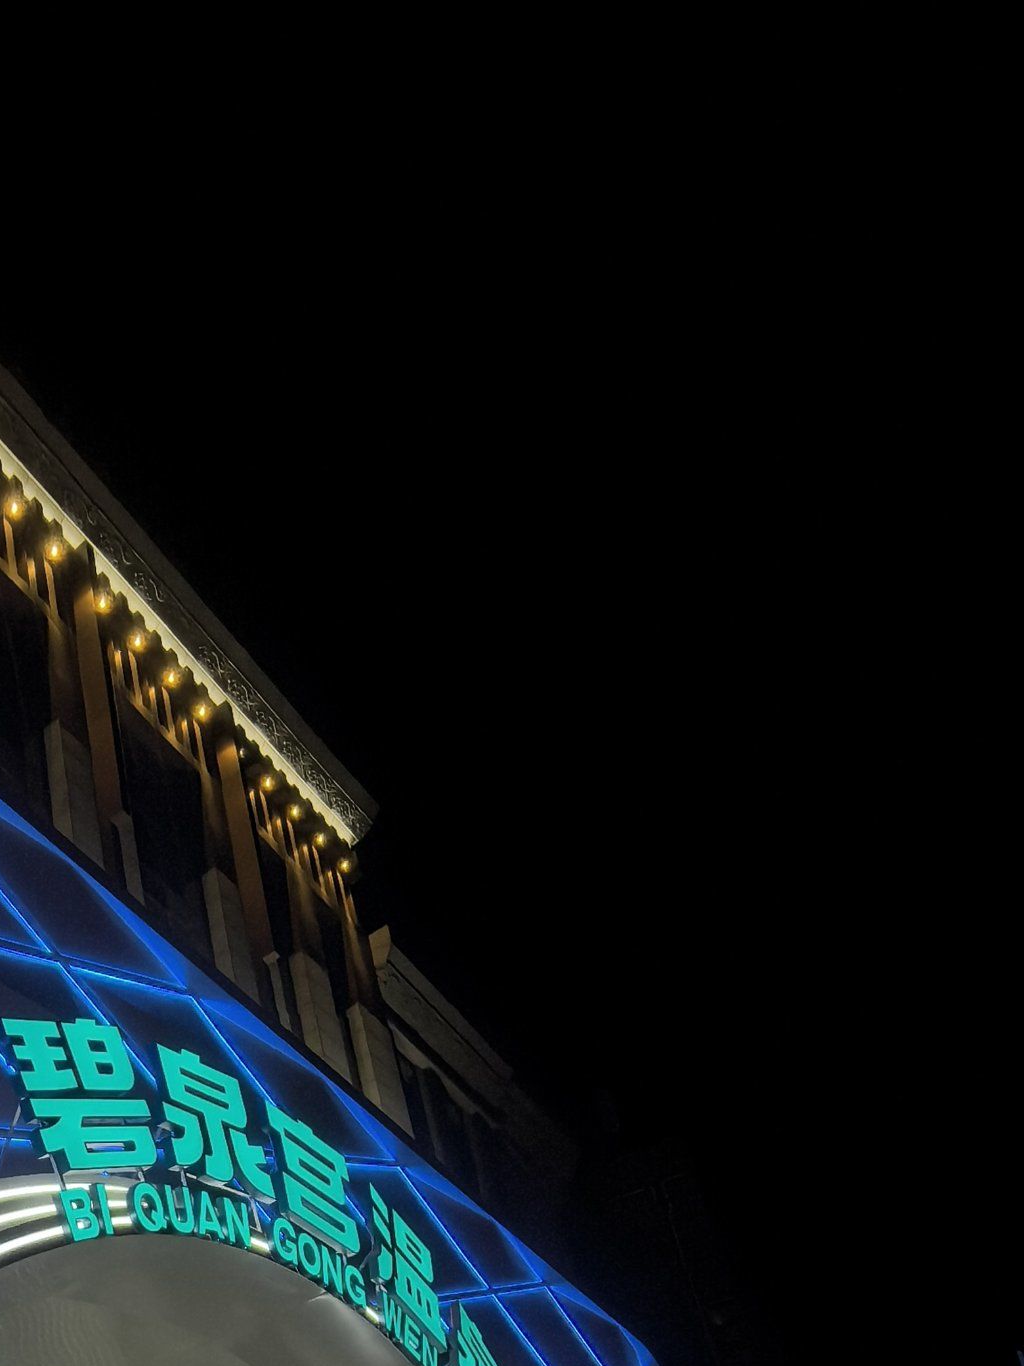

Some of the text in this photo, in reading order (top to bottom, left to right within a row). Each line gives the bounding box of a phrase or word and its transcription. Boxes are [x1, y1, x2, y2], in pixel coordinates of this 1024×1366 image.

[59, 1183, 114, 1242] BI
[131, 1182, 252, 1249] QUAN
[272, 1217, 368, 1309] GONG
